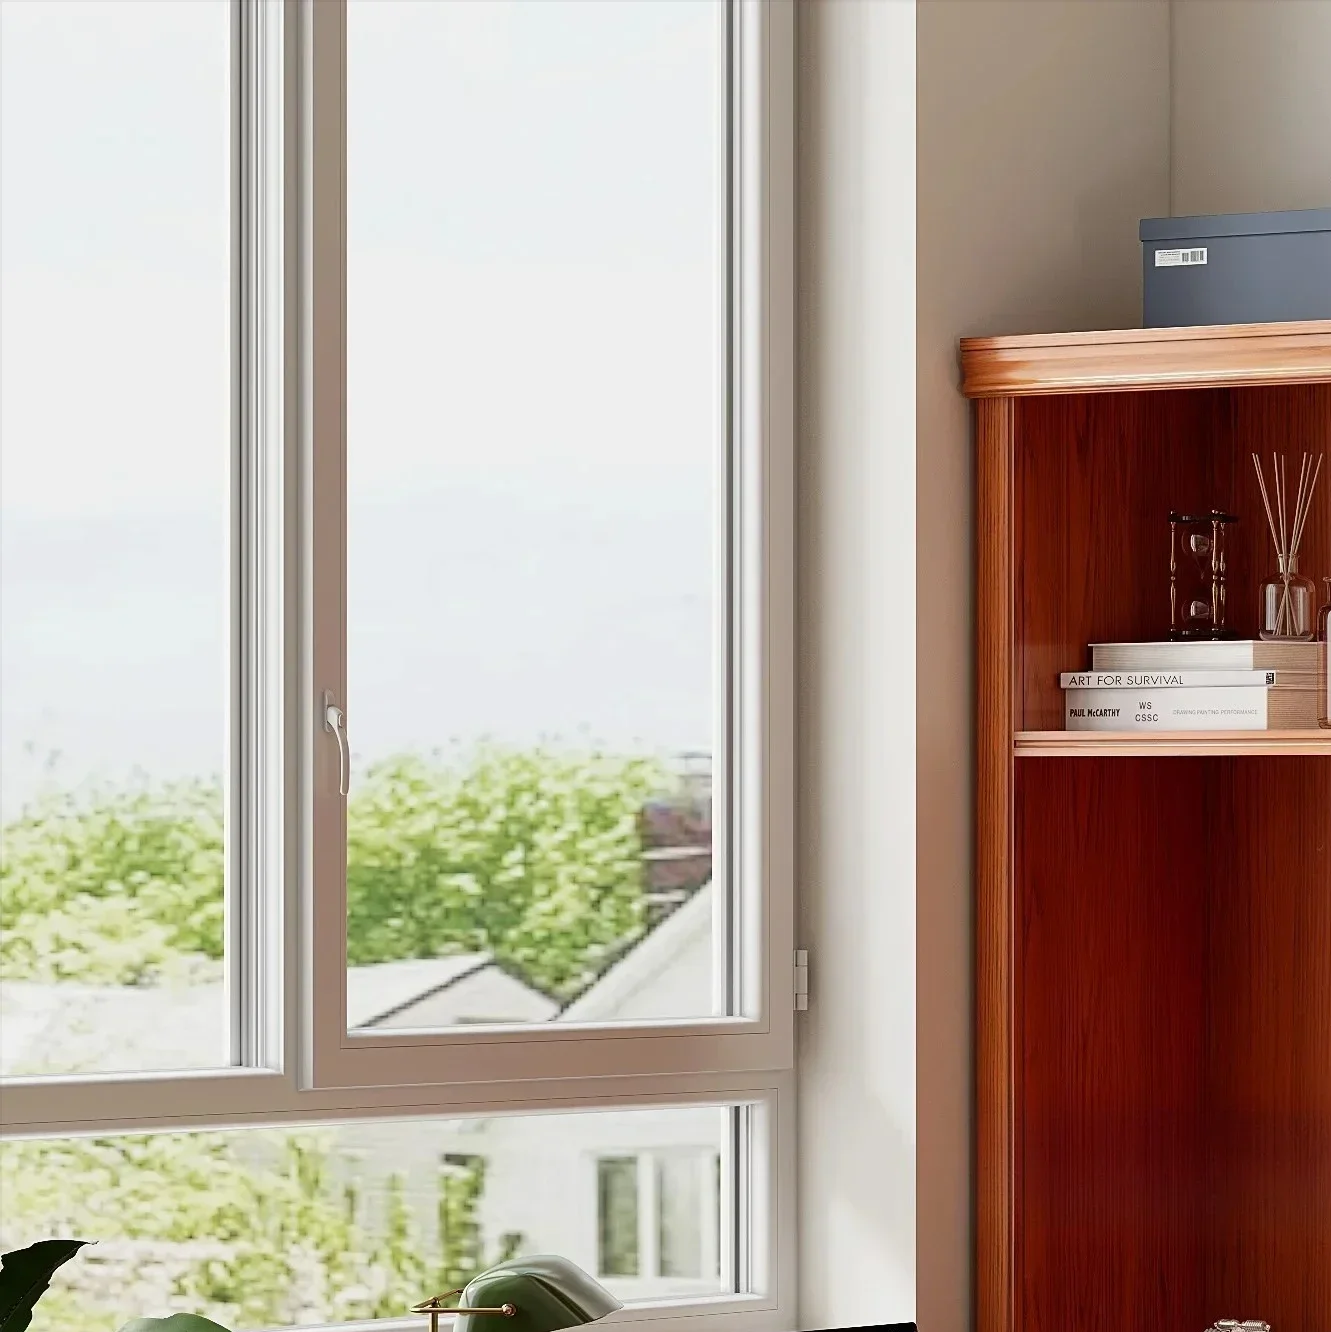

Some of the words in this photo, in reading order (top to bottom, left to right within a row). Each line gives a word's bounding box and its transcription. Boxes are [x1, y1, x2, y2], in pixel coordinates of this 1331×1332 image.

[1068, 675, 1092, 686] ART
[1097, 675, 1122, 686] FOR
[1127, 675, 1184, 685] SURVIVAL
[1138, 701, 1152, 710] WS
[1069, 708, 1086, 718] PAUL
[1087, 708, 1121, 718] McCARTHY
[1135, 713, 1159, 722] CSSC
